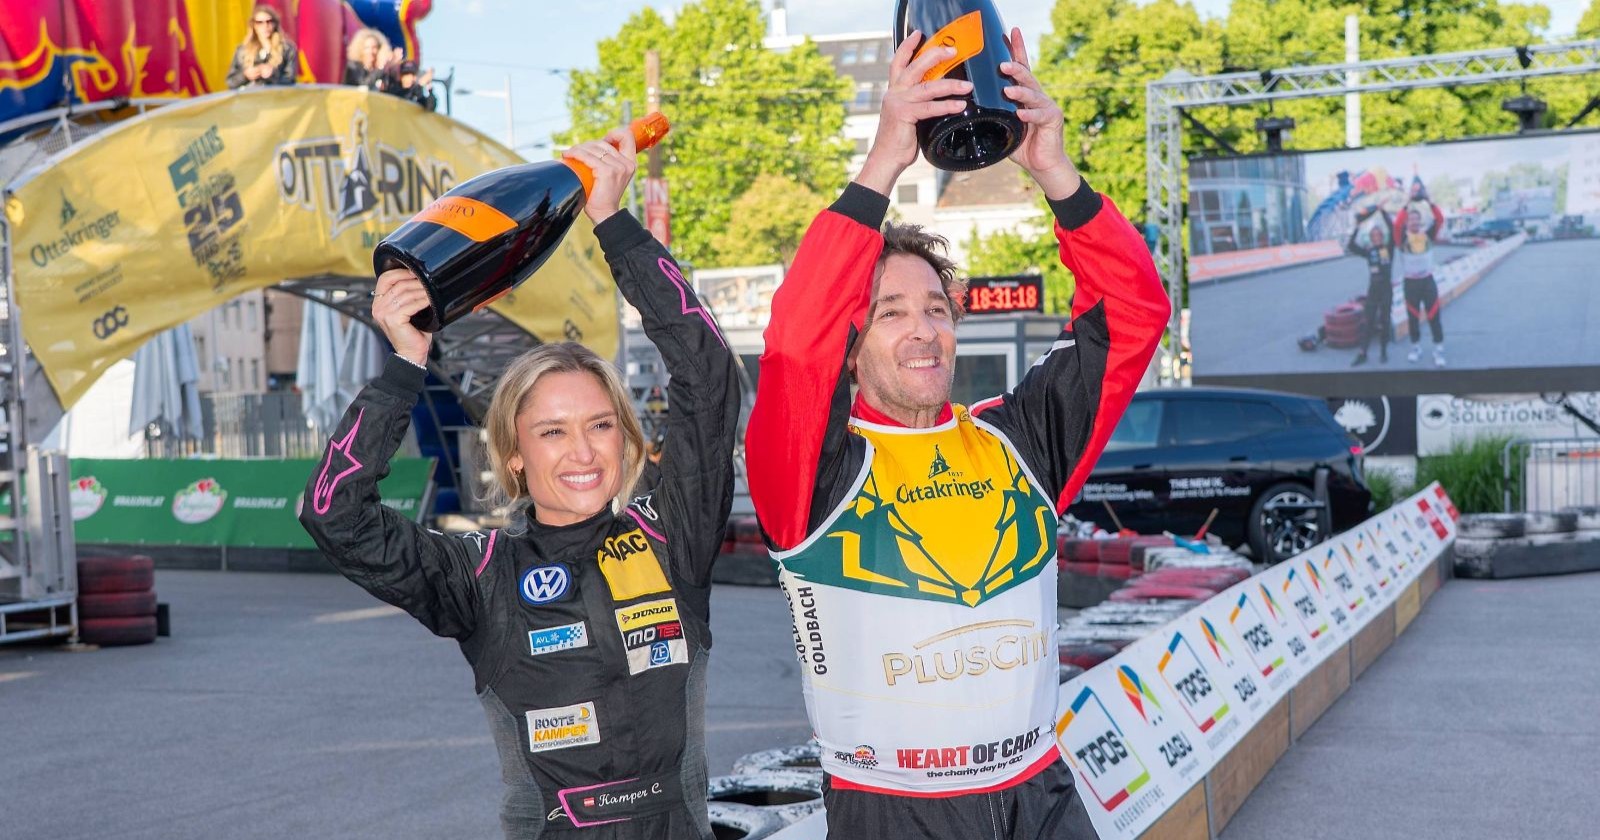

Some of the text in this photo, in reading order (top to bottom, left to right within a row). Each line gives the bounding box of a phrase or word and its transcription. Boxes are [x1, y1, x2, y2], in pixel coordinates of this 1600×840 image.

[30, 210, 120, 268] Ottakringer
[970, 285, 1037, 311] 18:31:18
[1450, 409, 1557, 424] SOLUTIONS
[526, 568, 565, 600] VW
[631, 605, 673, 620] DUNLOP
[536, 635, 550, 645] AVL
[797, 586, 828, 675] GOLDBACH
[652, 646, 668, 661] ZF
[1175, 667, 1213, 707] TIPOS
[534, 723, 589, 742] KAMPER
[896, 745, 970, 769] HEART
[972, 741, 1000, 765] OF
[1001, 726, 1041, 758] CART
[1075, 729, 1129, 779] TIPOS
[1158, 730, 1194, 768] ZAGU
[926, 770, 944, 778] the
[944, 767, 980, 777] charity
[979, 764, 998, 773] day
[997, 760, 1008, 770] by
[598, 788, 649, 807] Kamper
